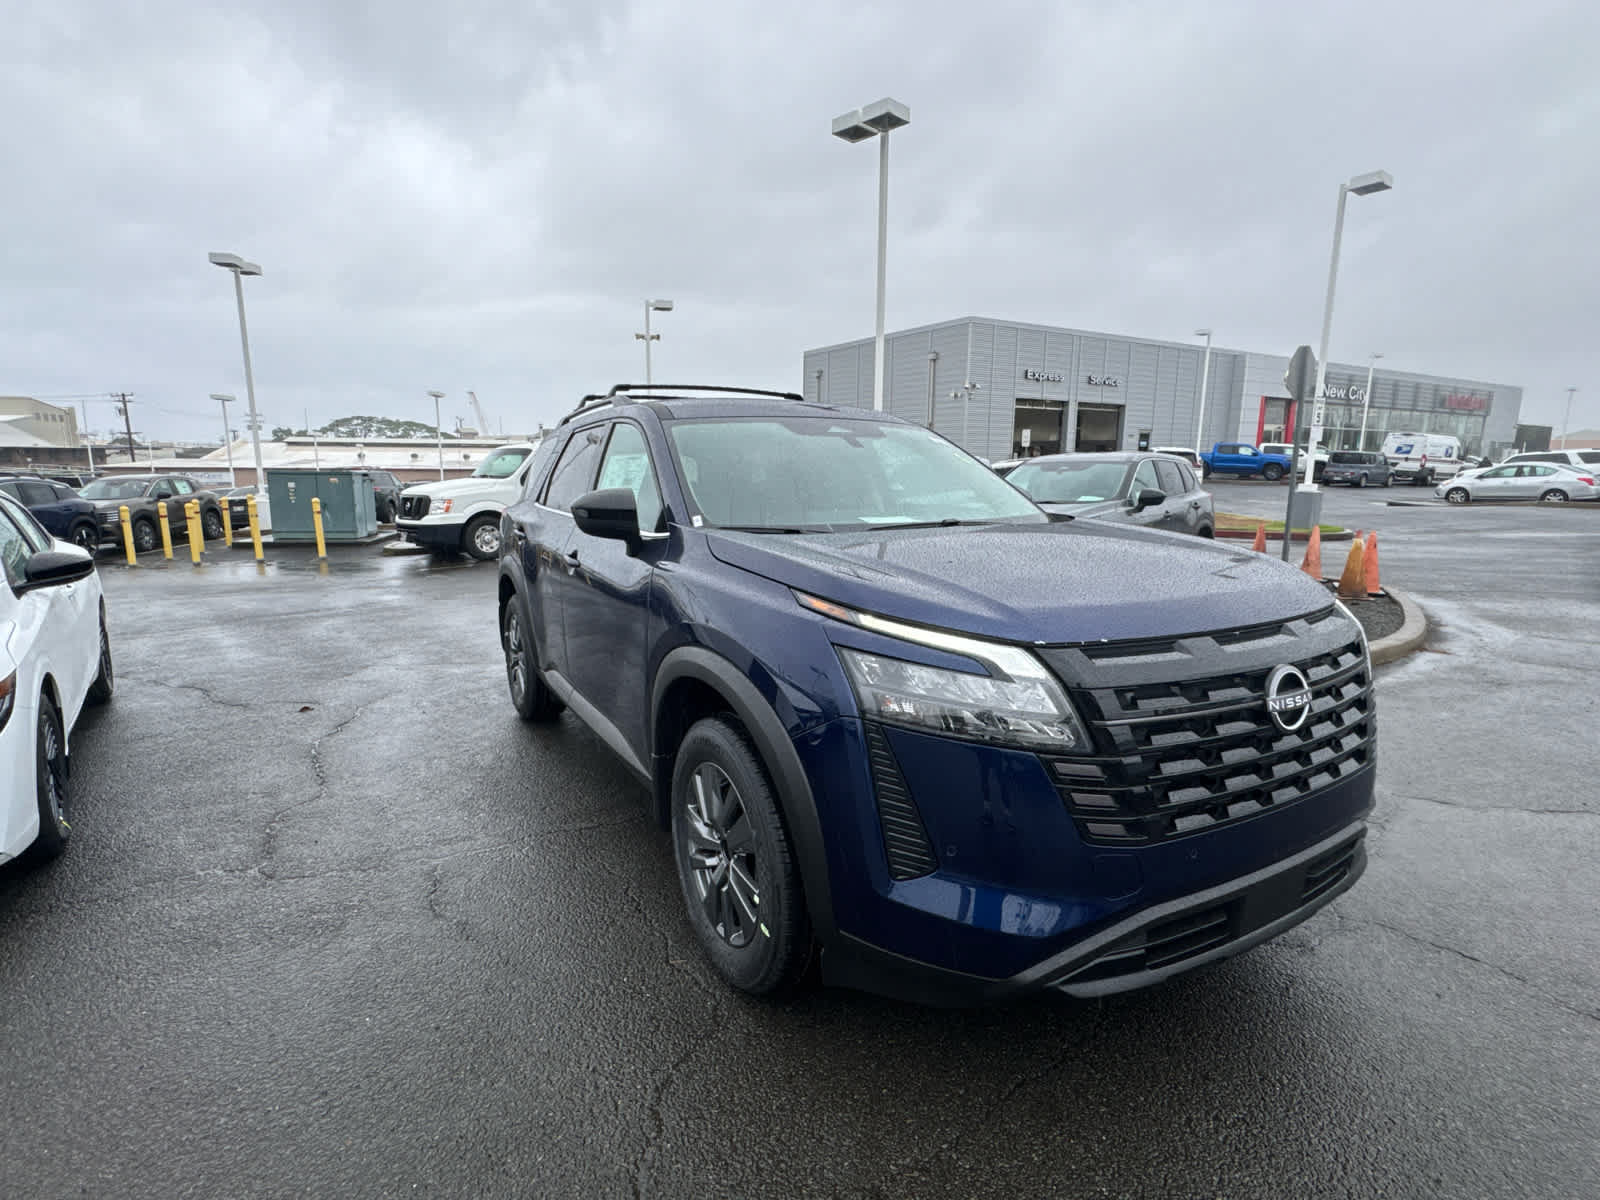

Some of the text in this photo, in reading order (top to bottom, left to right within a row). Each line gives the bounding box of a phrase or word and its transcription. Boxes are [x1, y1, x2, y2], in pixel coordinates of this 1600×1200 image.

[1025, 369, 1121, 387] Express Service
[1322, 383, 1368, 404] New City
